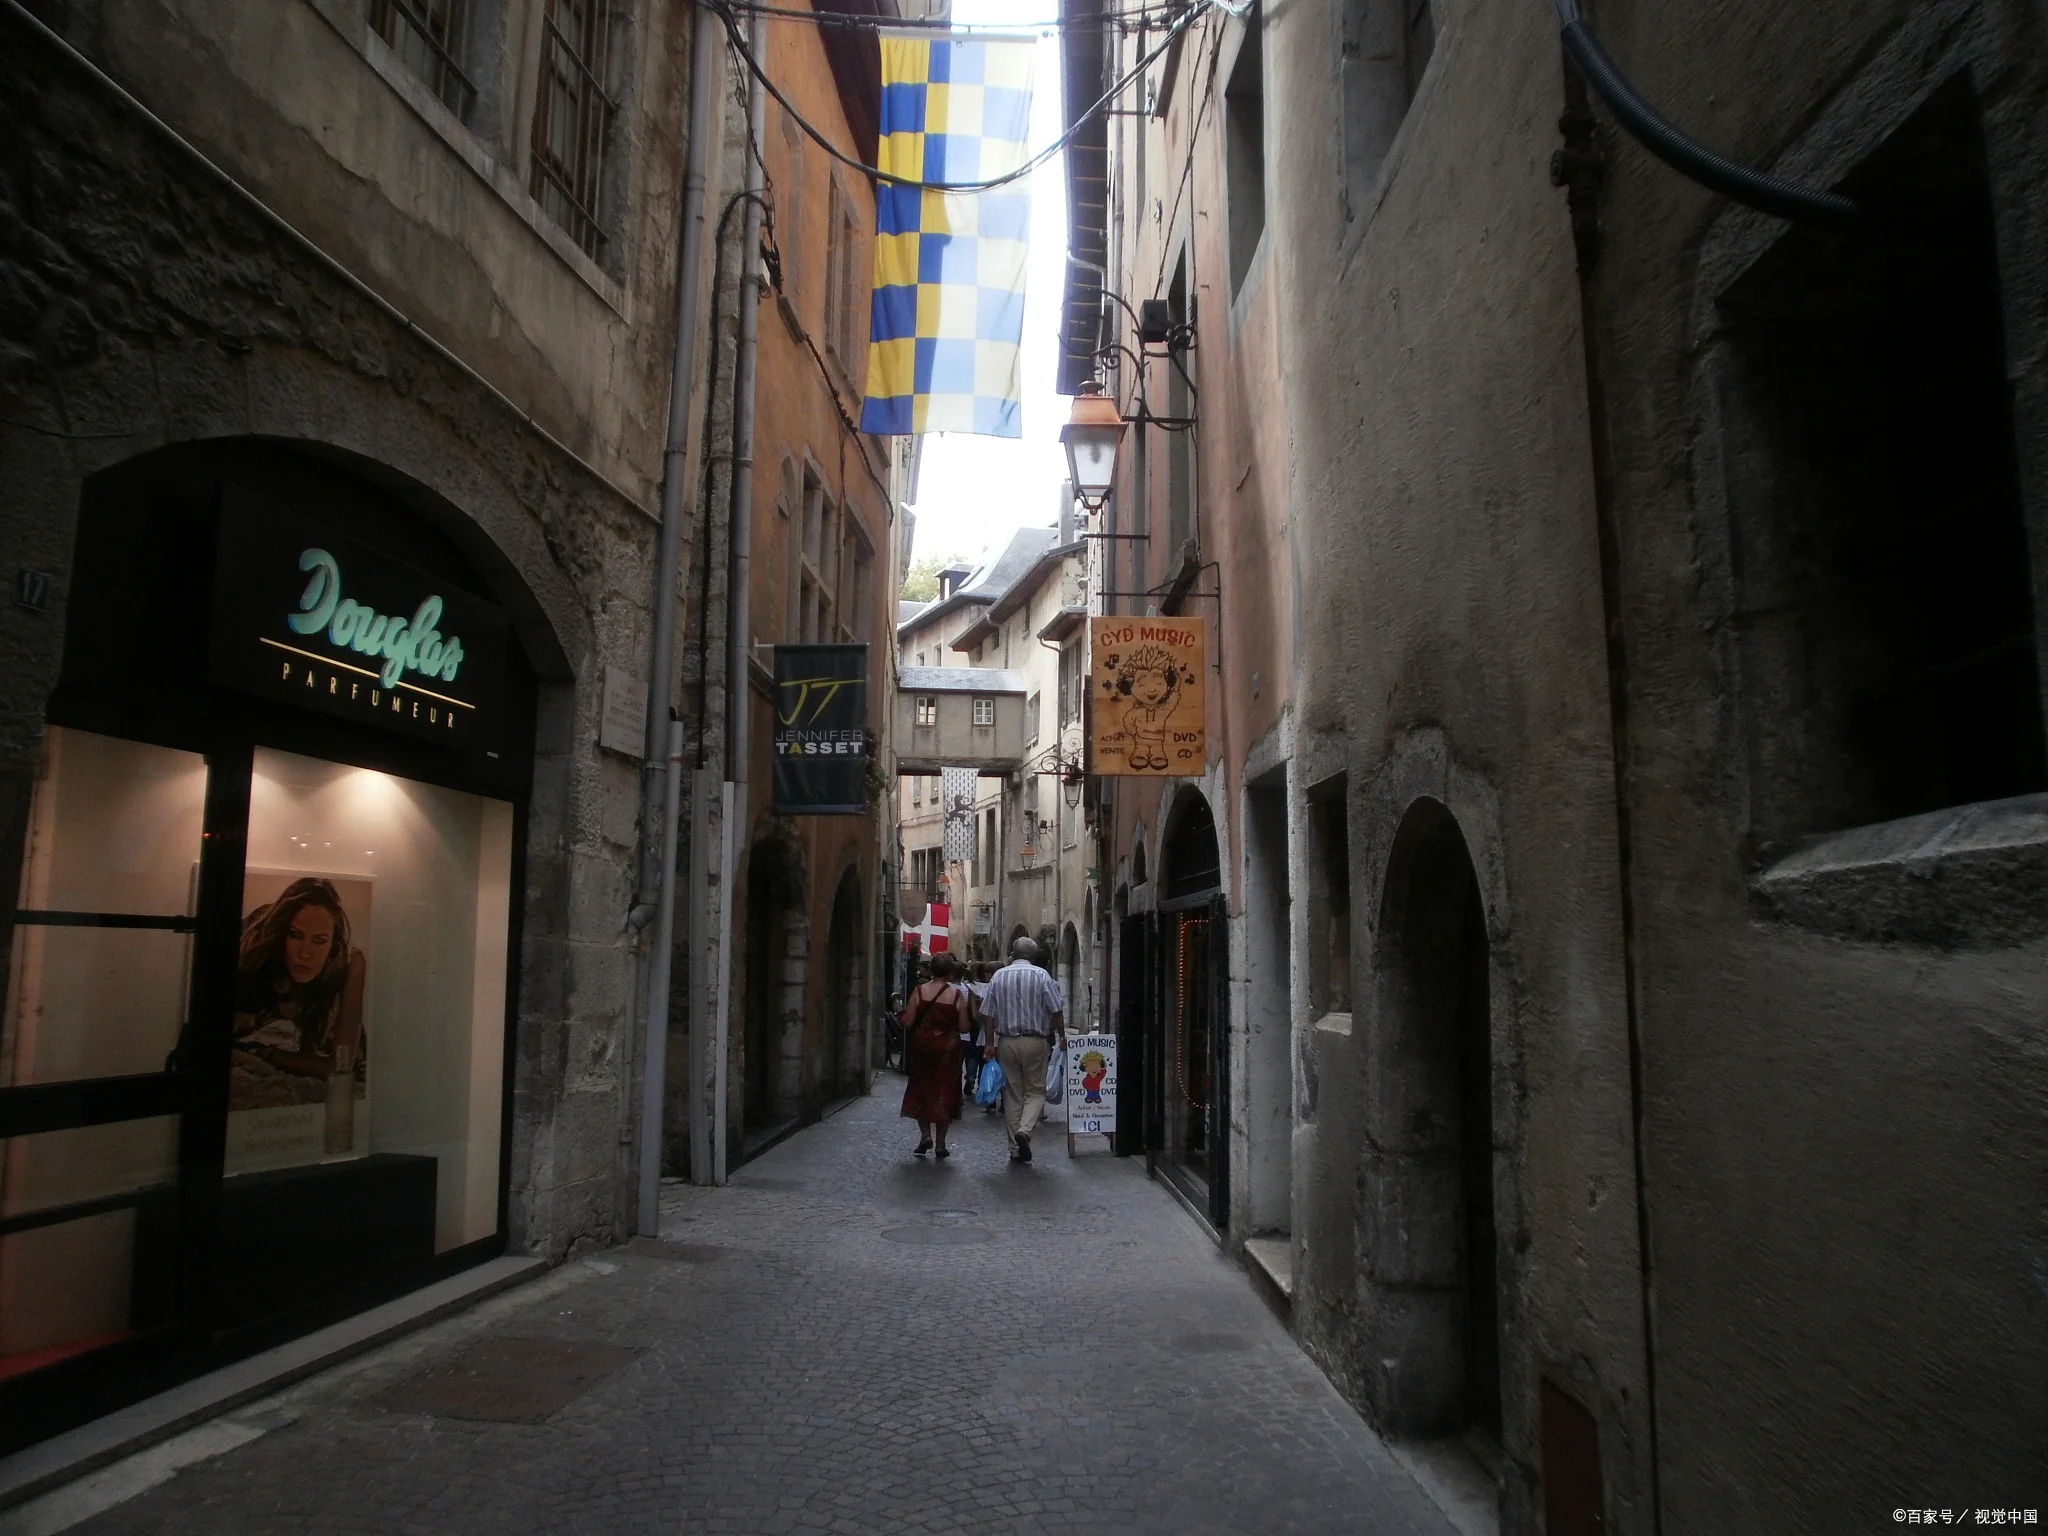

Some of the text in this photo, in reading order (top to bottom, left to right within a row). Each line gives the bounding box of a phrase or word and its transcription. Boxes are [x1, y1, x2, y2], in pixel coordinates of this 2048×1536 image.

[288, 547, 465, 689] Douglas
[1100, 627, 1196, 648] CYD MUSIC
[282, 663, 455, 730] PARFUMEUR
[775, 730, 863, 742] JENNIFER
[1173, 732, 1197, 742] DVD
[776, 741, 863, 754] TASSET
[1100, 747, 1126, 755] VENTE
[1177, 748, 1192, 759] CD
[1068, 1037, 1116, 1049] CYD MUSIC
[1068, 1078, 1080, 1086] CD
[1105, 1077, 1117, 1085] CD
[1069, 1088, 1086, 1096] DVD
[1101, 1088, 1117, 1096] DVD
[1083, 1120, 1101, 1132] ICI
